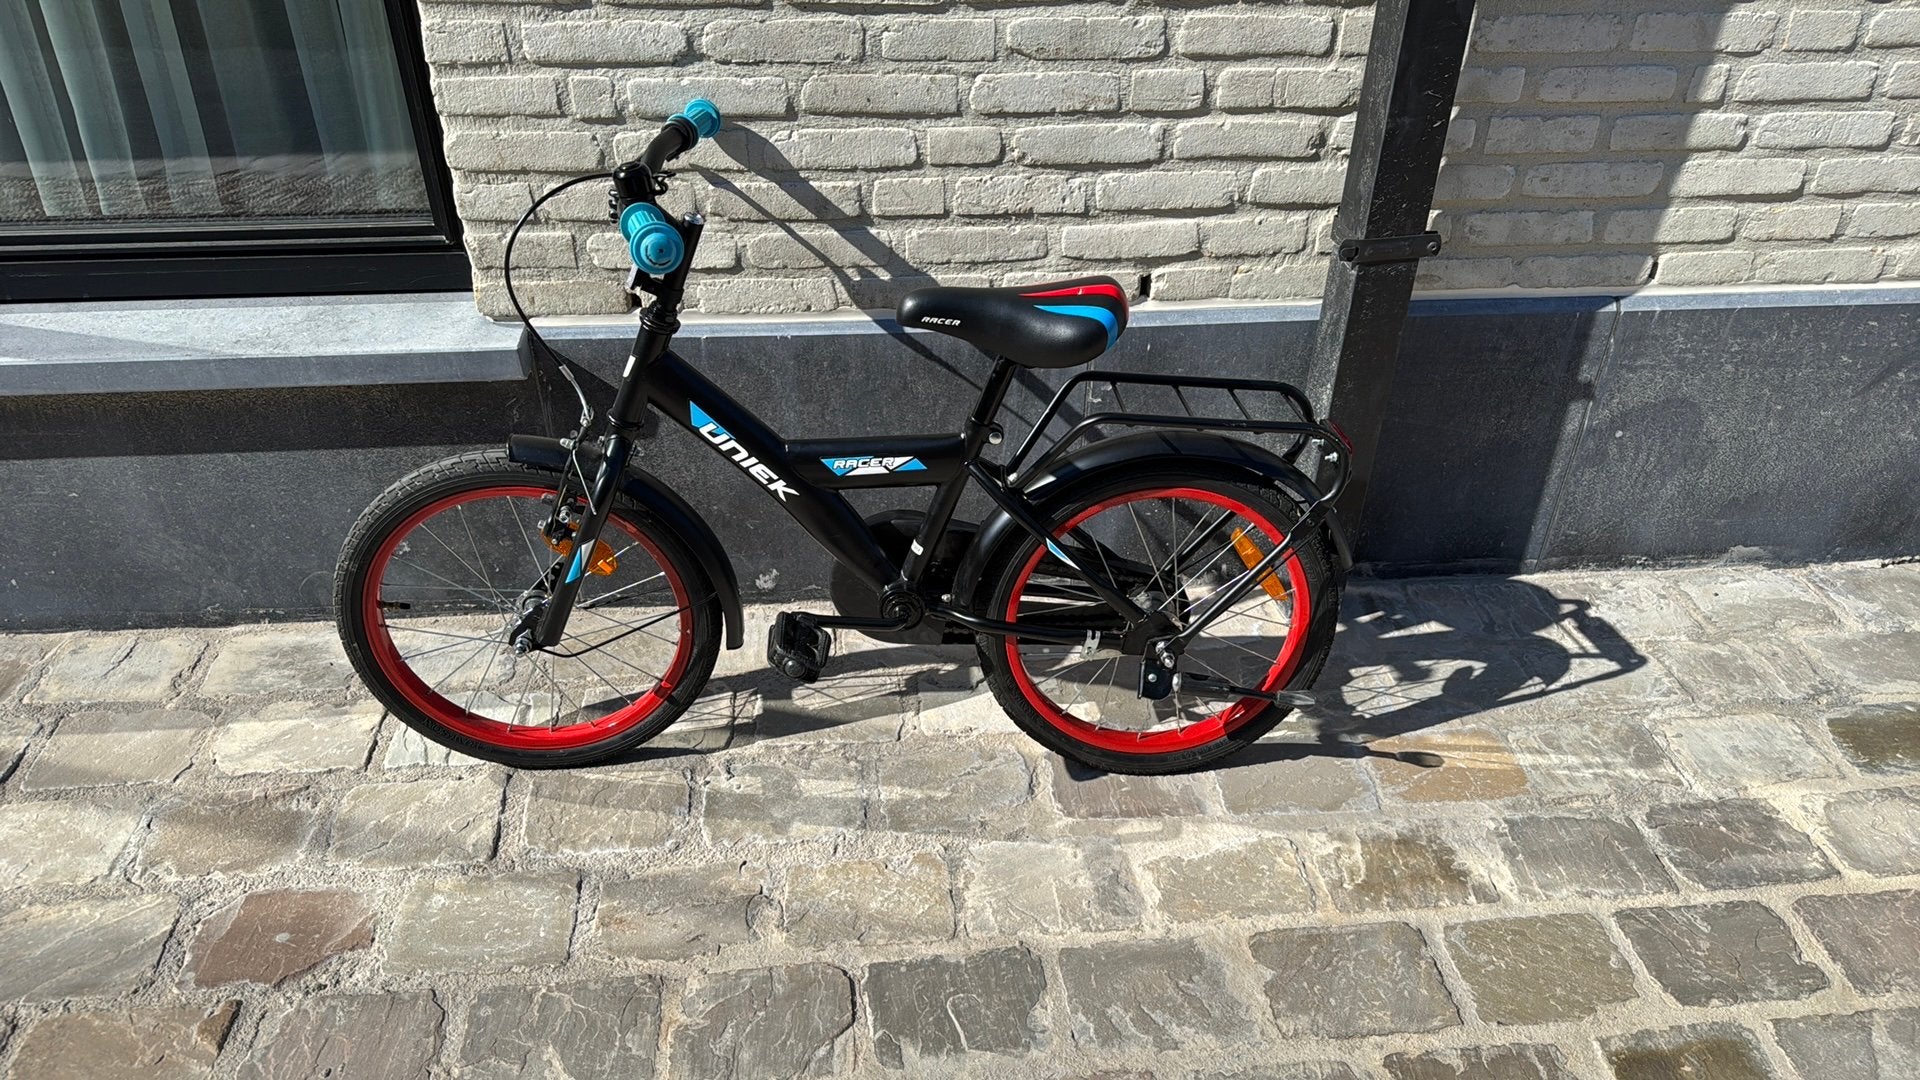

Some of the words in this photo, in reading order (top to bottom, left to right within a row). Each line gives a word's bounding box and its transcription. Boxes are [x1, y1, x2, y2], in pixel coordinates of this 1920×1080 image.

[921, 316, 961, 326] RACER
[699, 423, 800, 502] UNIEK
[834, 458, 895, 469] RACER
